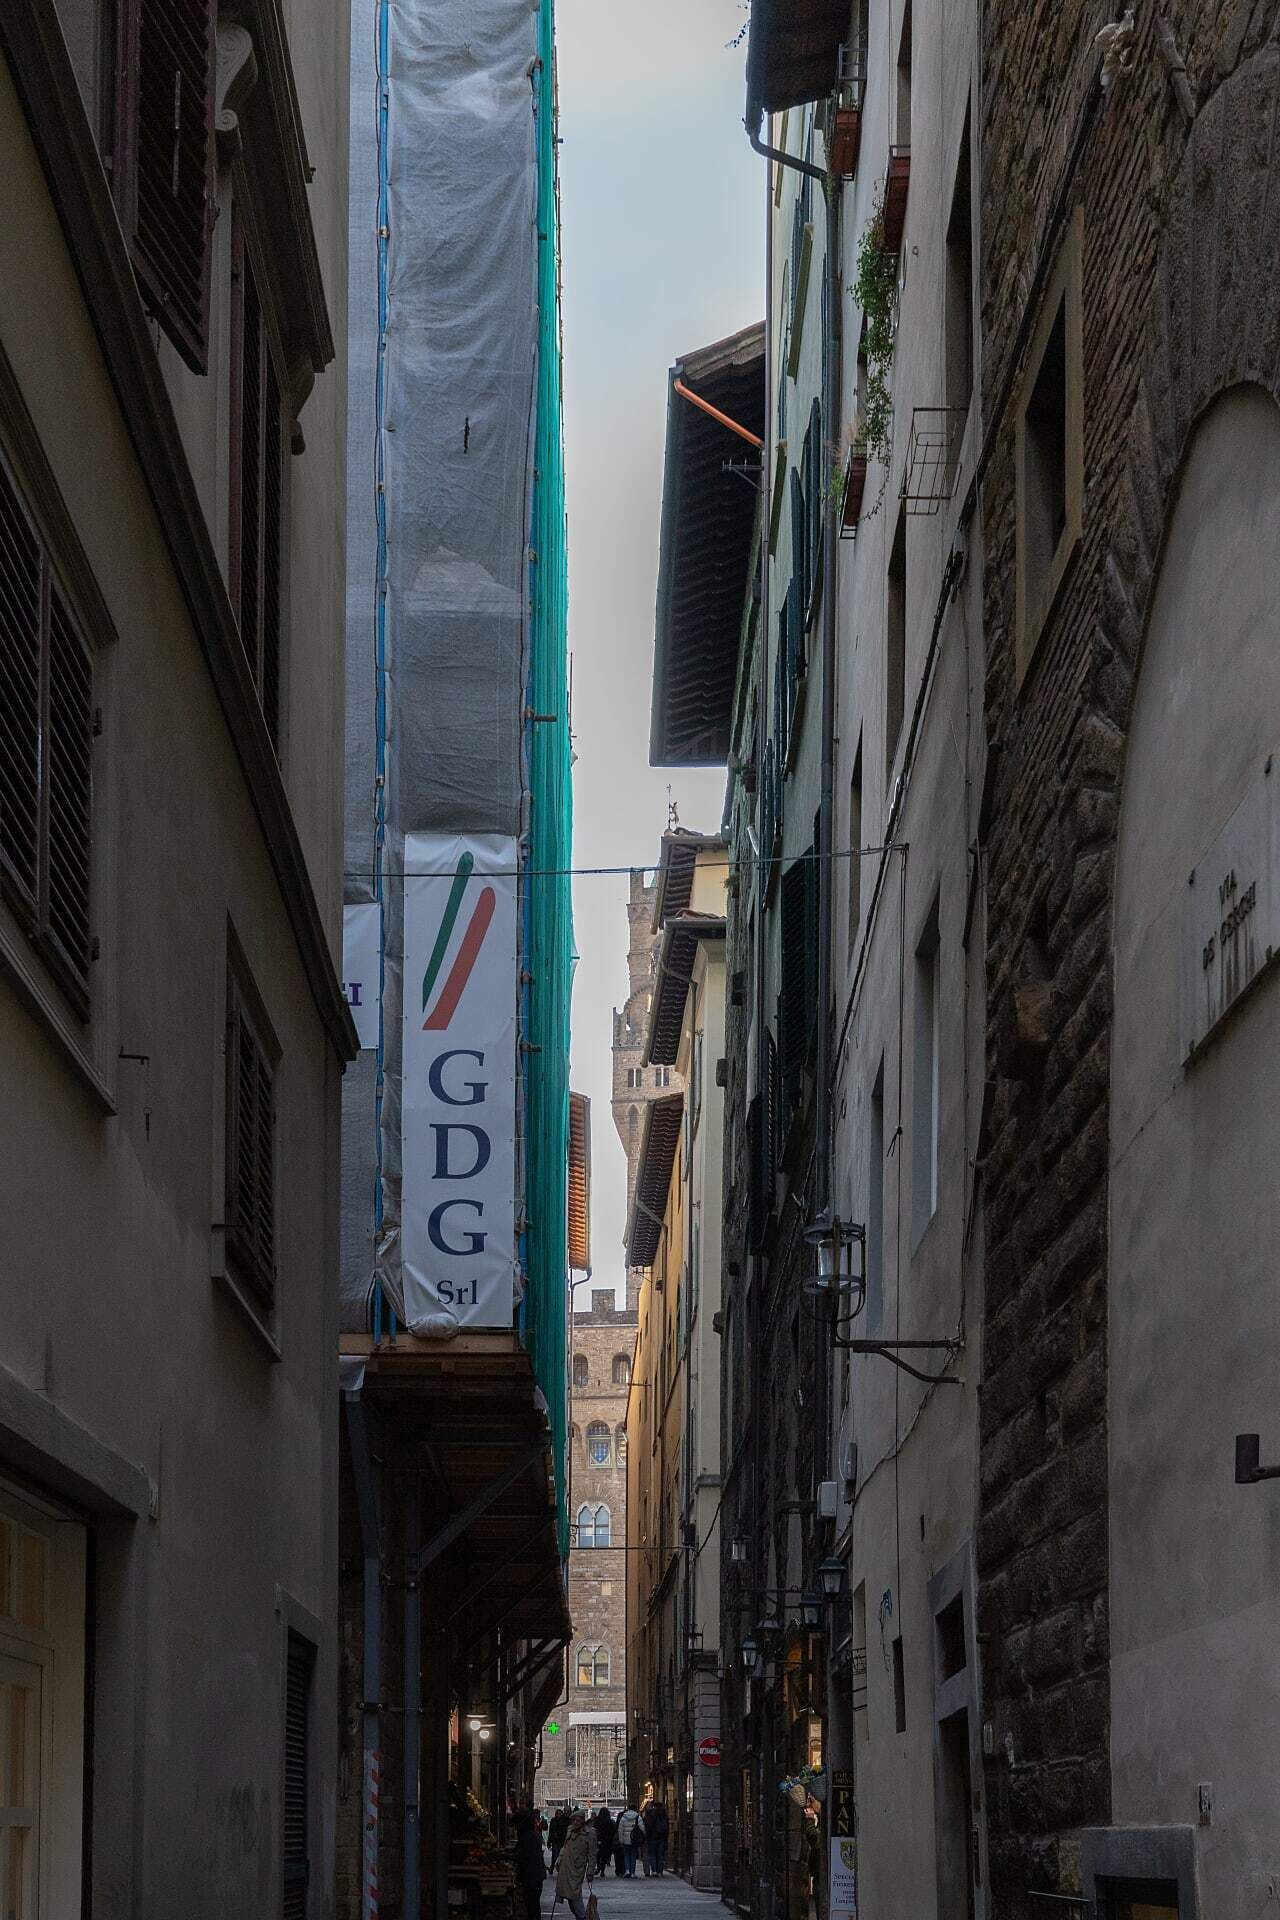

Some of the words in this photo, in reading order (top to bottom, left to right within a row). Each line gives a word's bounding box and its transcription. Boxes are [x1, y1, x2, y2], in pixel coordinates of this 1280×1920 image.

[1219, 869, 1236, 905] VIA
[1220, 881, 1256, 946] CERCHI
[436, 1280, 479, 1305] Srl
